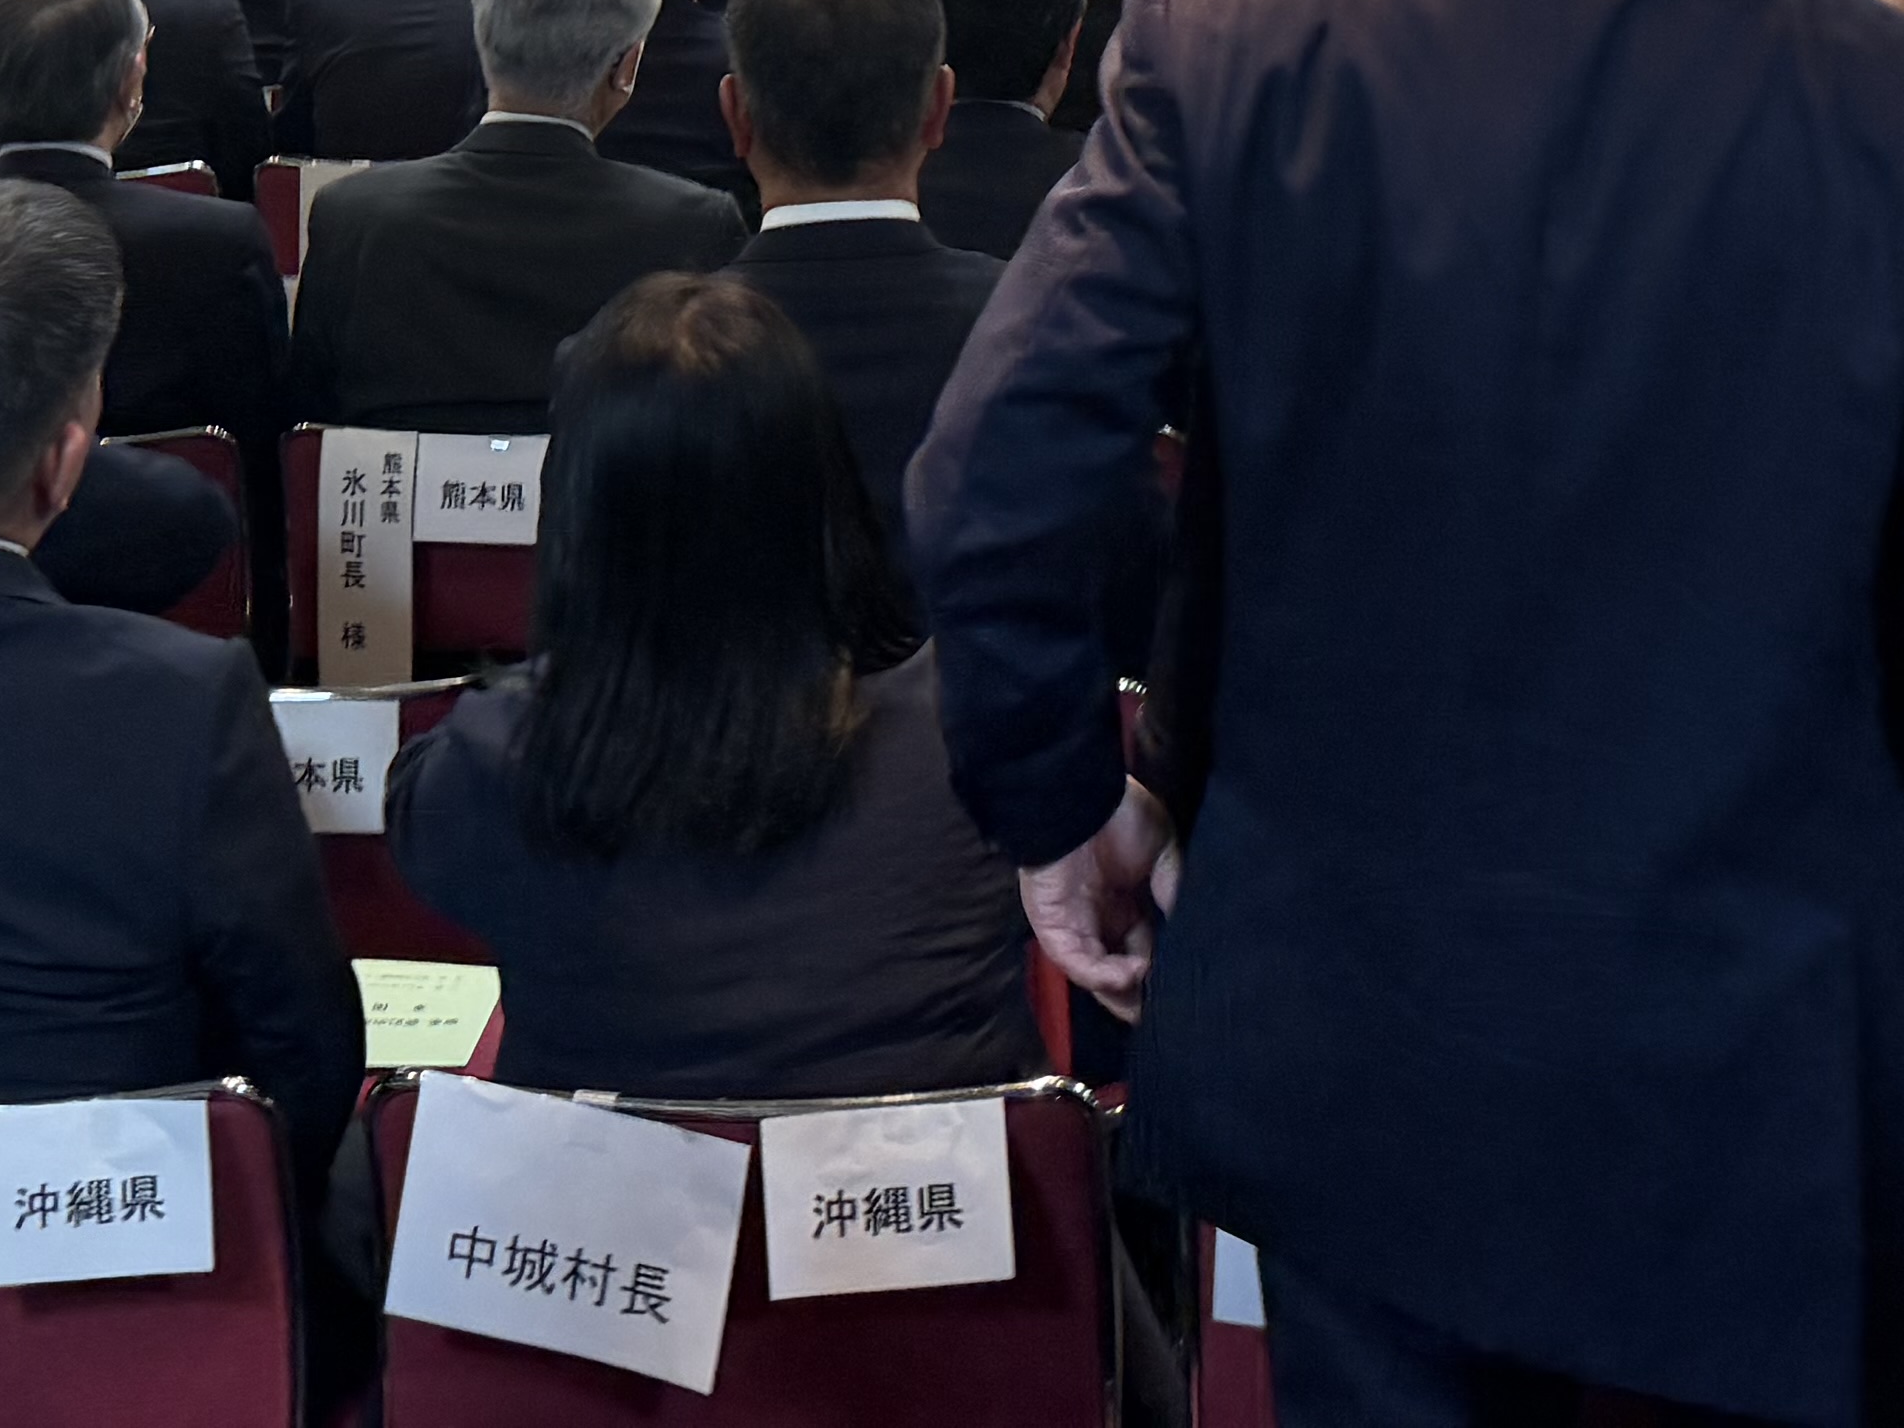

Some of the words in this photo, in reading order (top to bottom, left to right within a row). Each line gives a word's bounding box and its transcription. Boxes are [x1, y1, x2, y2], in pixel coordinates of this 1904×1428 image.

[380, 450, 403, 525] 熊本県
[439, 477, 527, 514] 熊本県
[340, 467, 368, 590] 氷川町長
[294, 755, 365, 796] 本県
[13, 1174, 167, 1232] 沖縄県
[811, 1182, 966, 1241] 沖縄県
[446, 1223, 674, 1327] 中城村長
